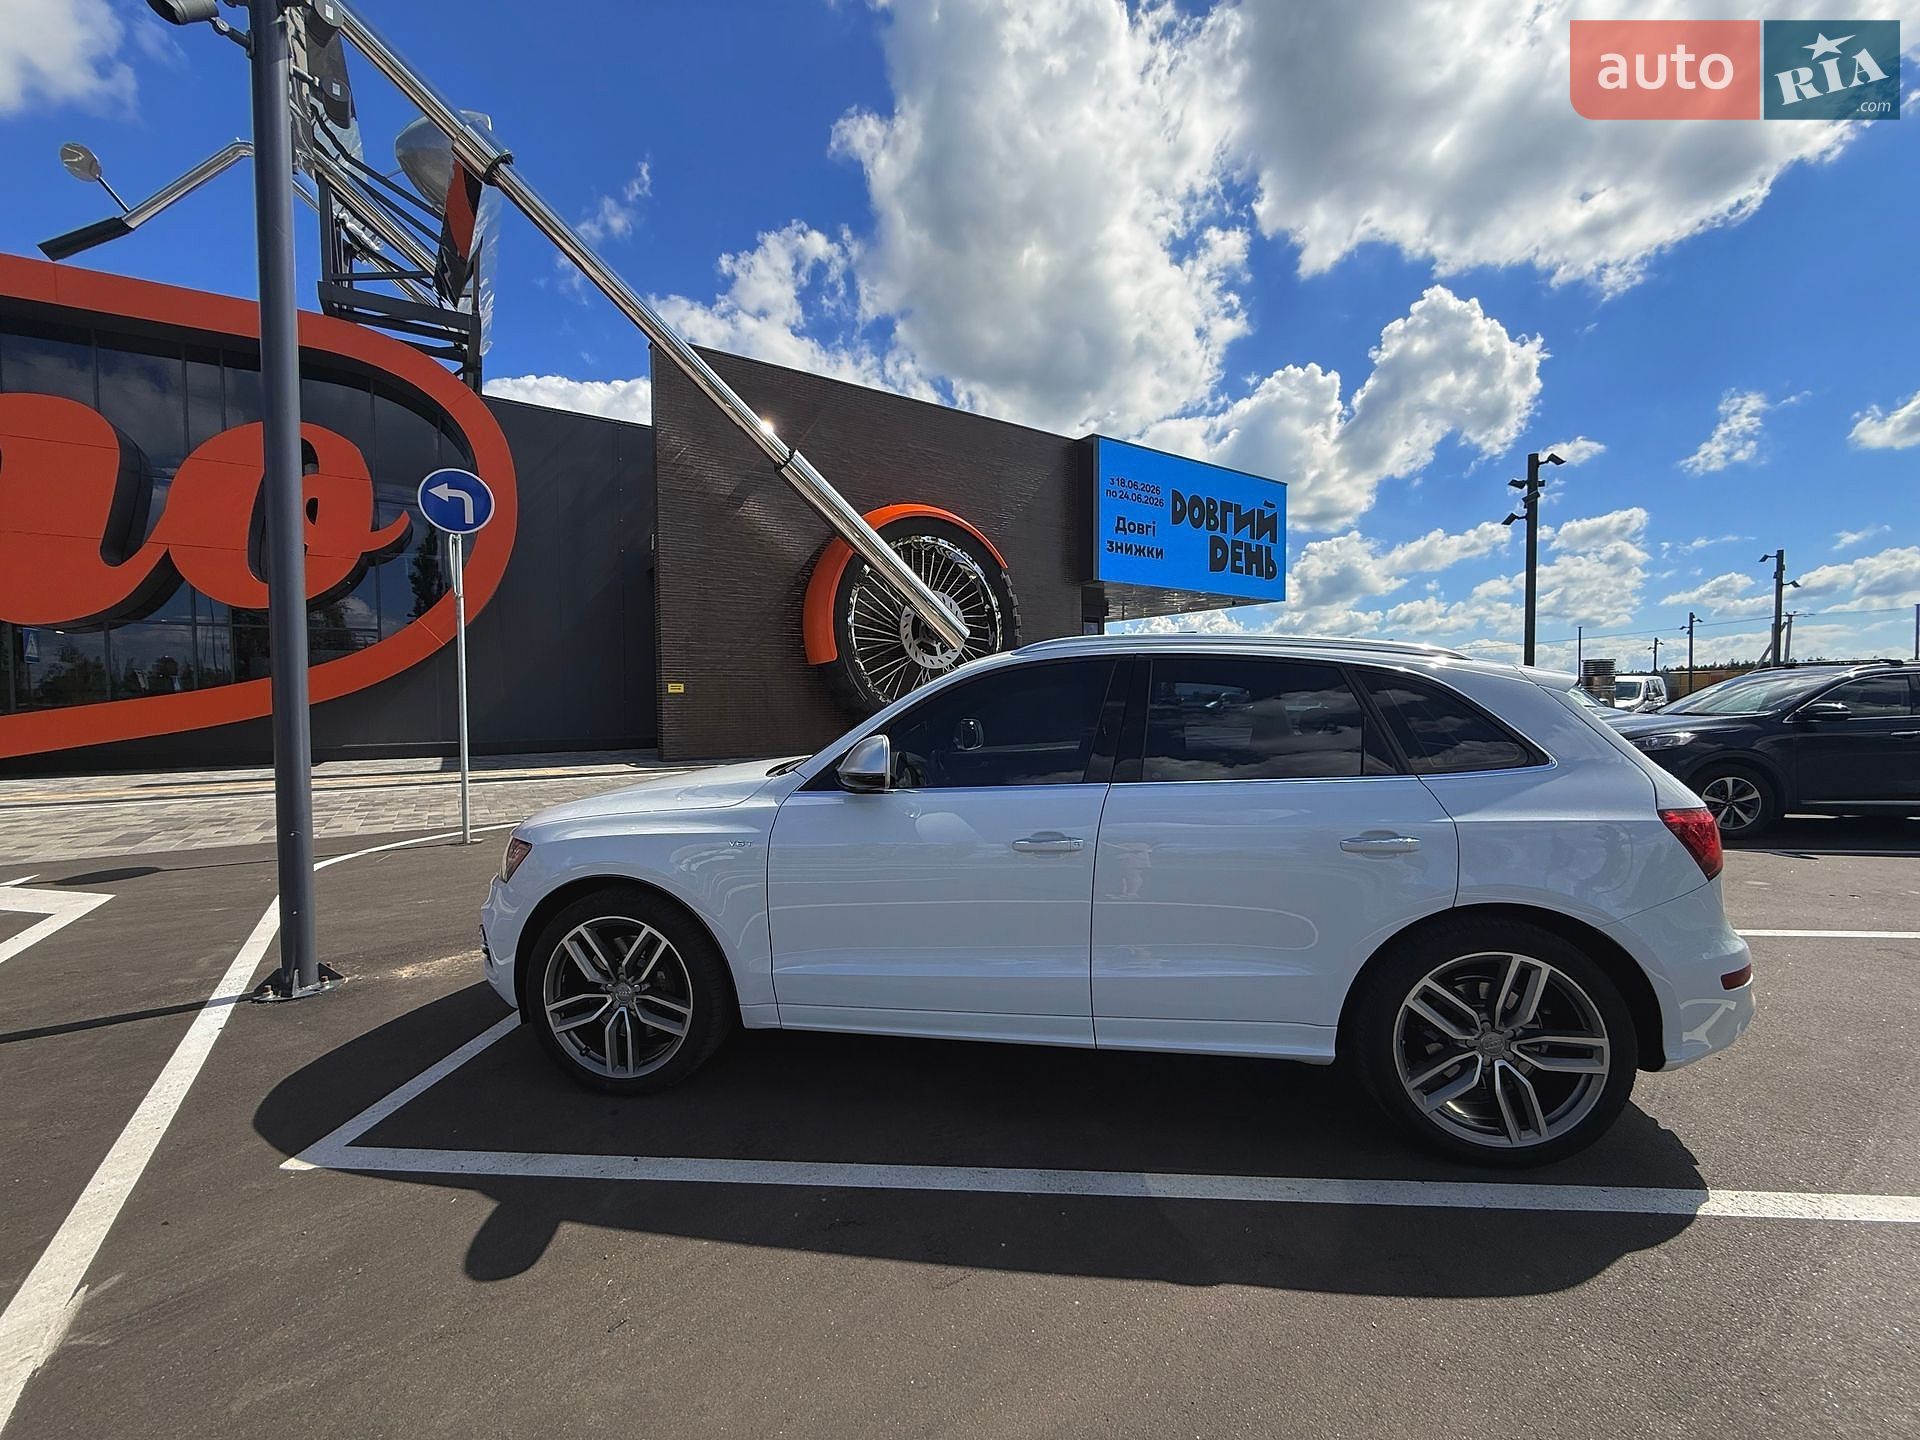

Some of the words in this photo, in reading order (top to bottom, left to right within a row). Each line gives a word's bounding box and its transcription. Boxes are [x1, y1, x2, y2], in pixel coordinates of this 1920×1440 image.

[1116, 477, 1161, 495] 18.06.2026
[1106, 488, 1118, 498] по
[1119, 490, 1165, 508] 24.06.2026
[1115, 515, 1156, 537] Довгі
[1106, 540, 1164, 560] знижки
